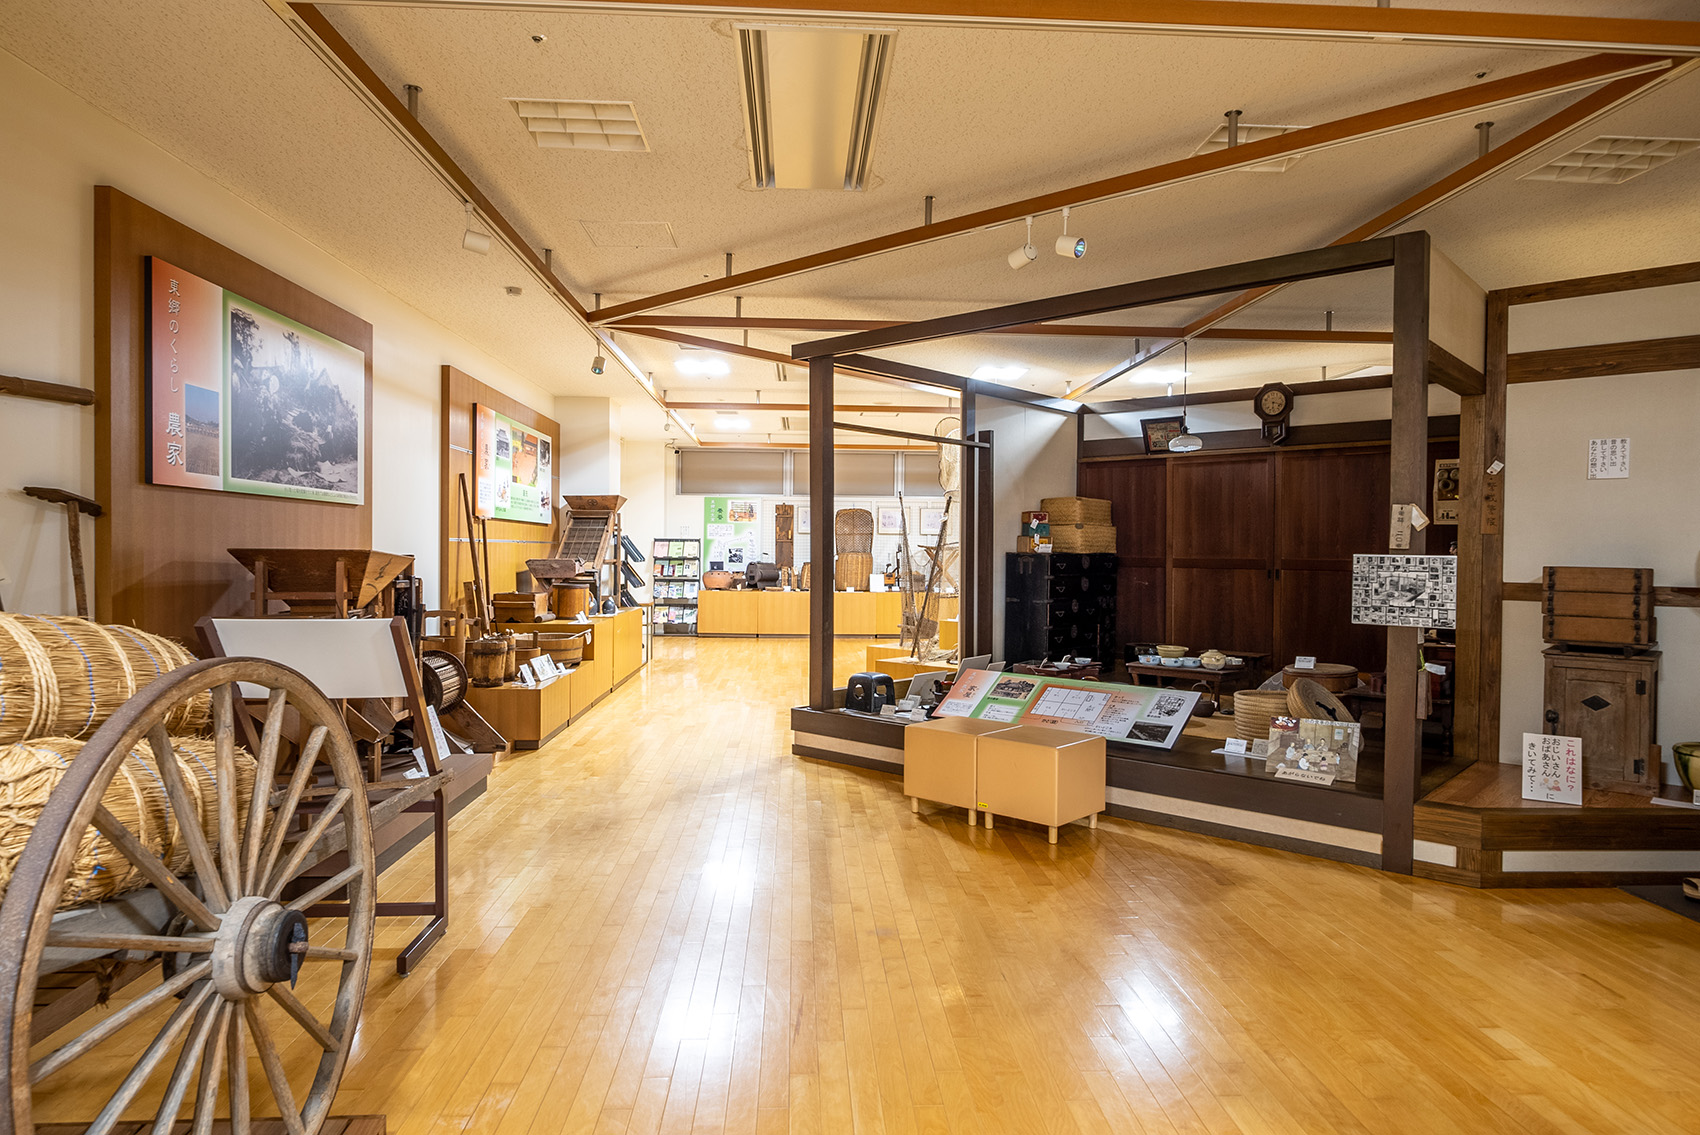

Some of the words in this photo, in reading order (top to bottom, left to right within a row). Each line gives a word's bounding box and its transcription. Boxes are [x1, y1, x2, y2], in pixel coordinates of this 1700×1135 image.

[168, 278, 181, 394] 東郷のくらし
[166, 411, 184, 467] 農家
[1599, 439, 1608, 473] 話して下さい
[1619, 438, 1628, 472] 教えて下さい
[1541, 737, 1551, 778] おばあさん
[1551, 738, 1561, 779] おじいさん
[1546, 792, 1555, 800] に
